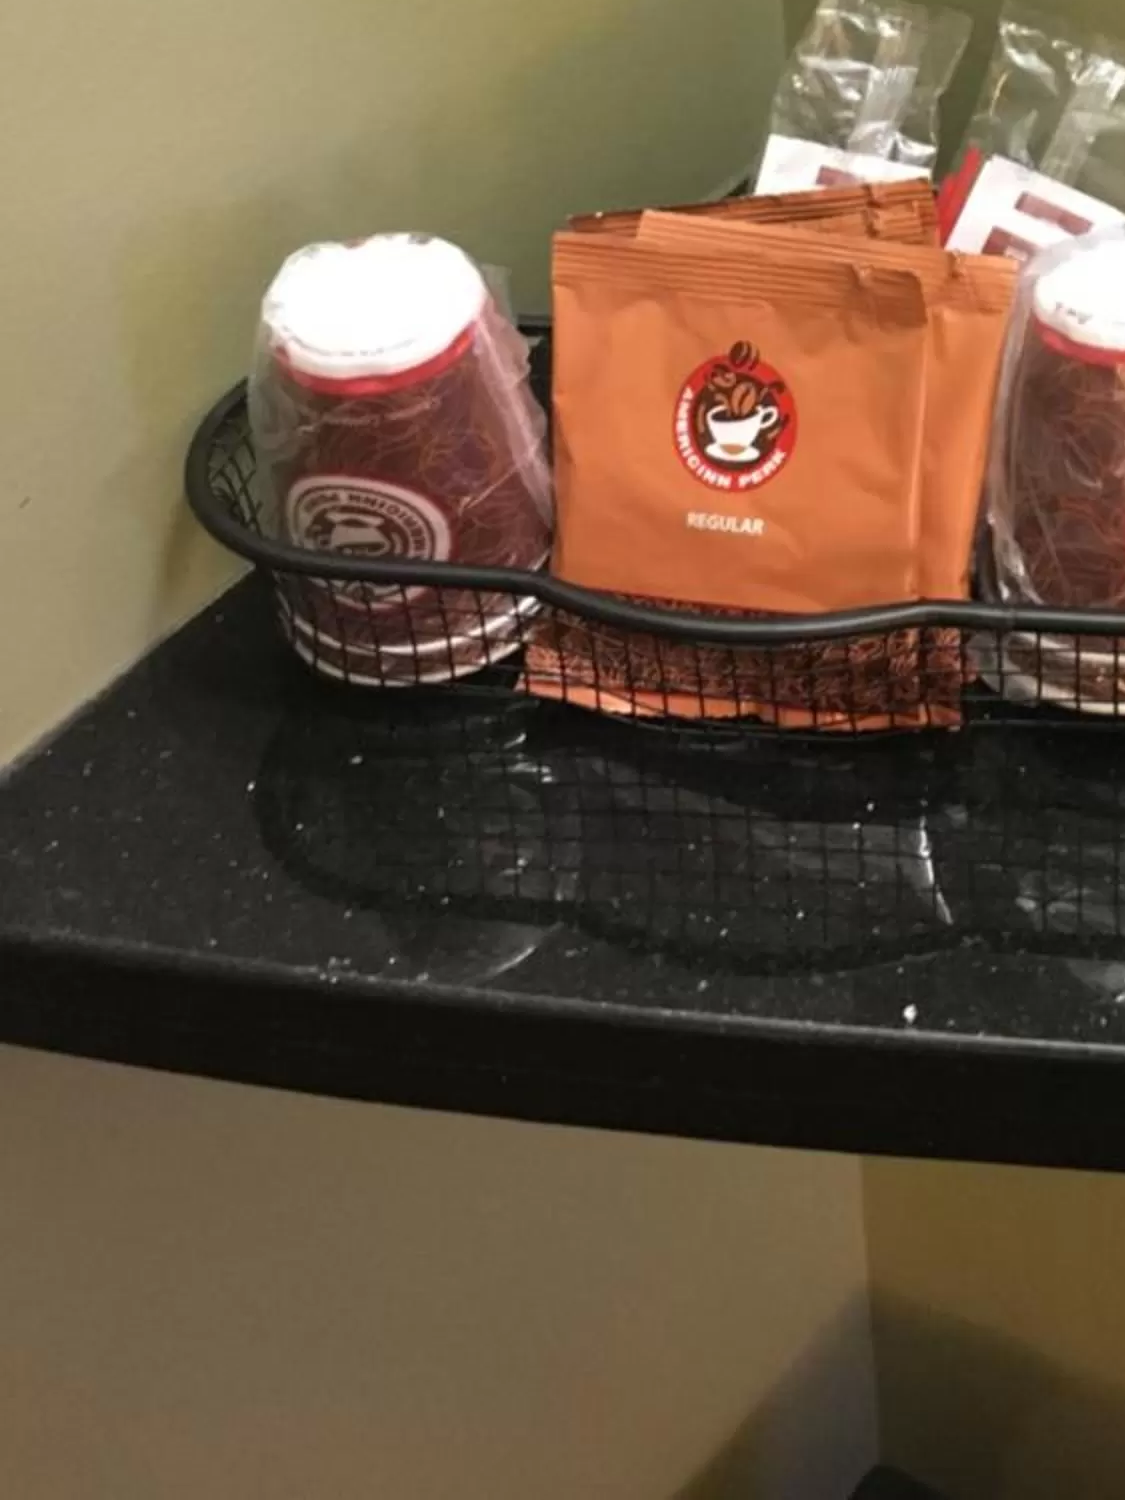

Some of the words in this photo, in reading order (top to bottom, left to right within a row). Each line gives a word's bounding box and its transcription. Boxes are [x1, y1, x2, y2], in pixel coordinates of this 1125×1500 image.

[675, 386, 732, 489] AMERICINN
[737, 448, 787, 489] PERK
[686, 511, 765, 536] REGULAR
